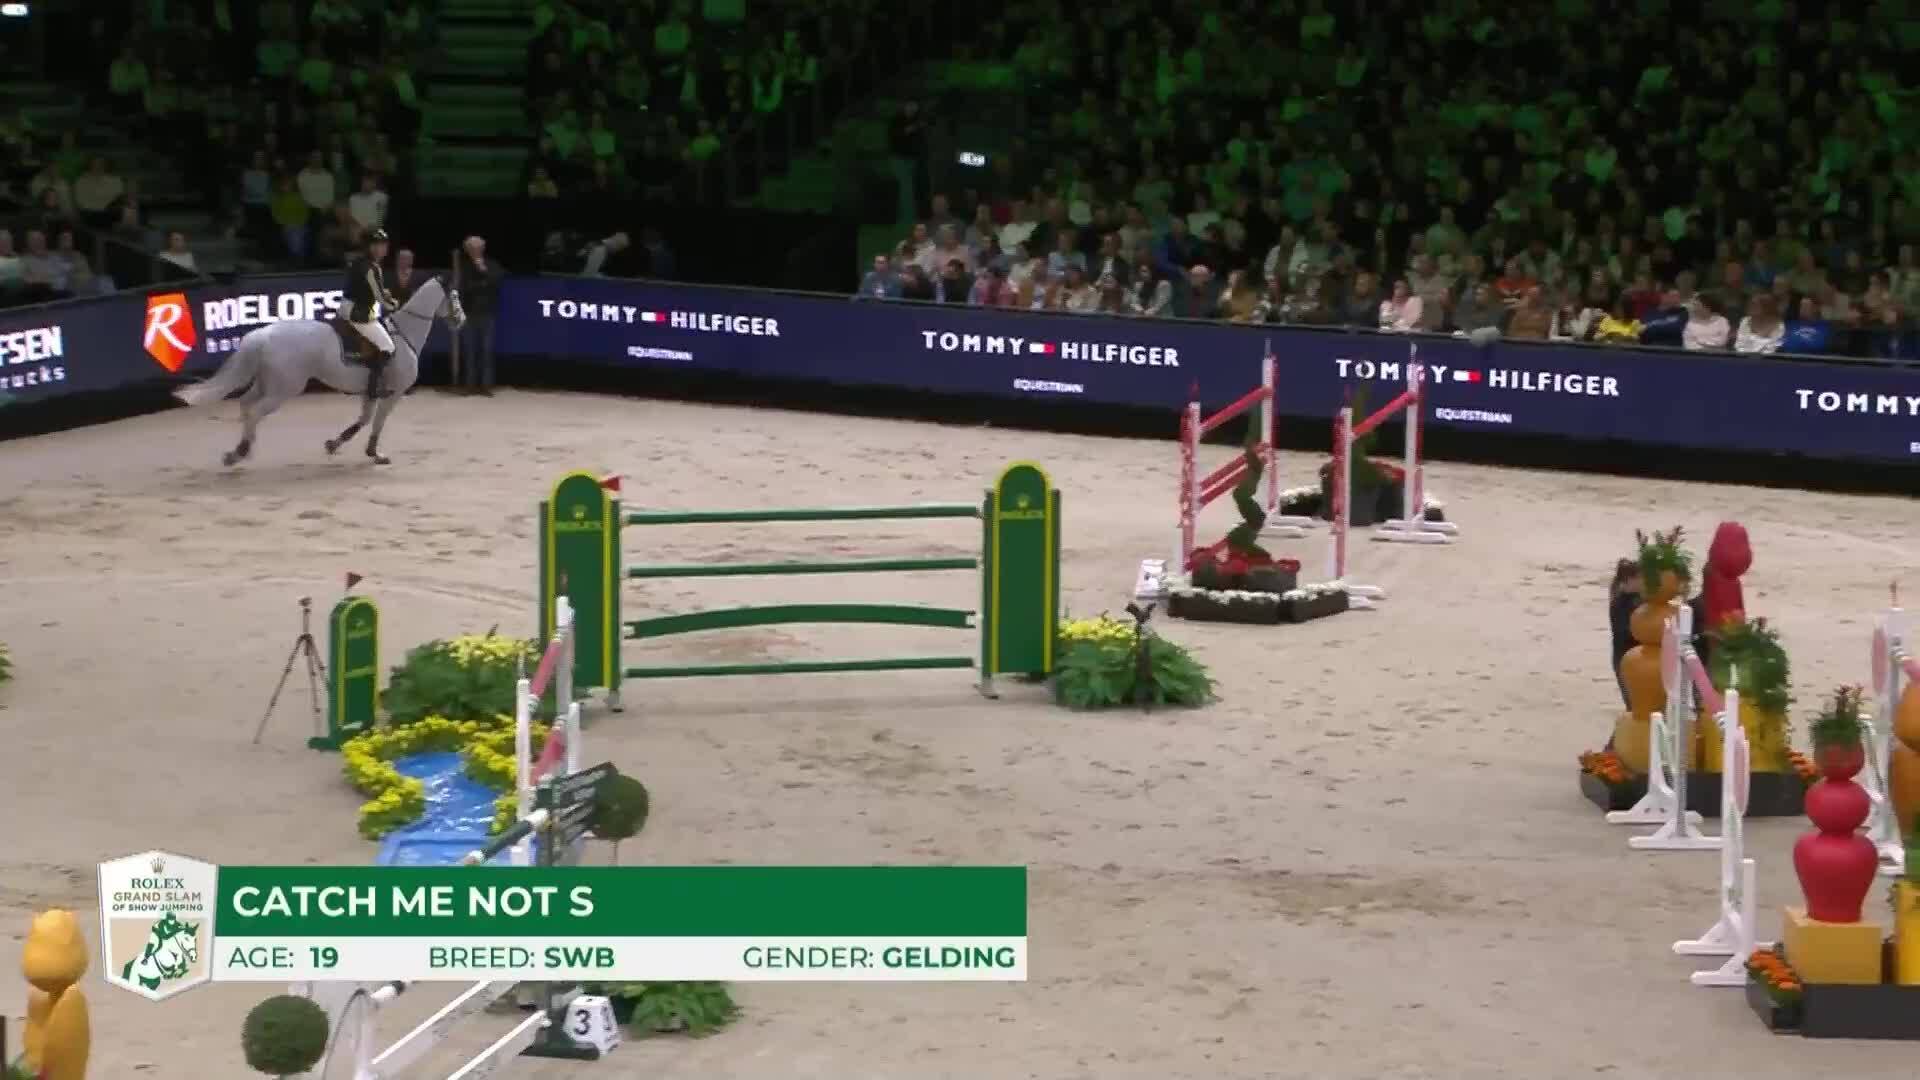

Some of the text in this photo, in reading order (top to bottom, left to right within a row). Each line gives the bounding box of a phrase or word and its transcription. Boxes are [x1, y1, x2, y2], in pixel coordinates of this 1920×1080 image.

[538, 300, 780, 337] TOMMY HILFIGER
[922, 331, 1180, 367] TOMMY HILFIGER
[1489, 369, 1620, 397] HILFIGER
[1435, 407, 1513, 424] EQUESTRIAN
[1796, 389, 1920, 416] TOMMY
[573, 1008, 592, 1035] 3
